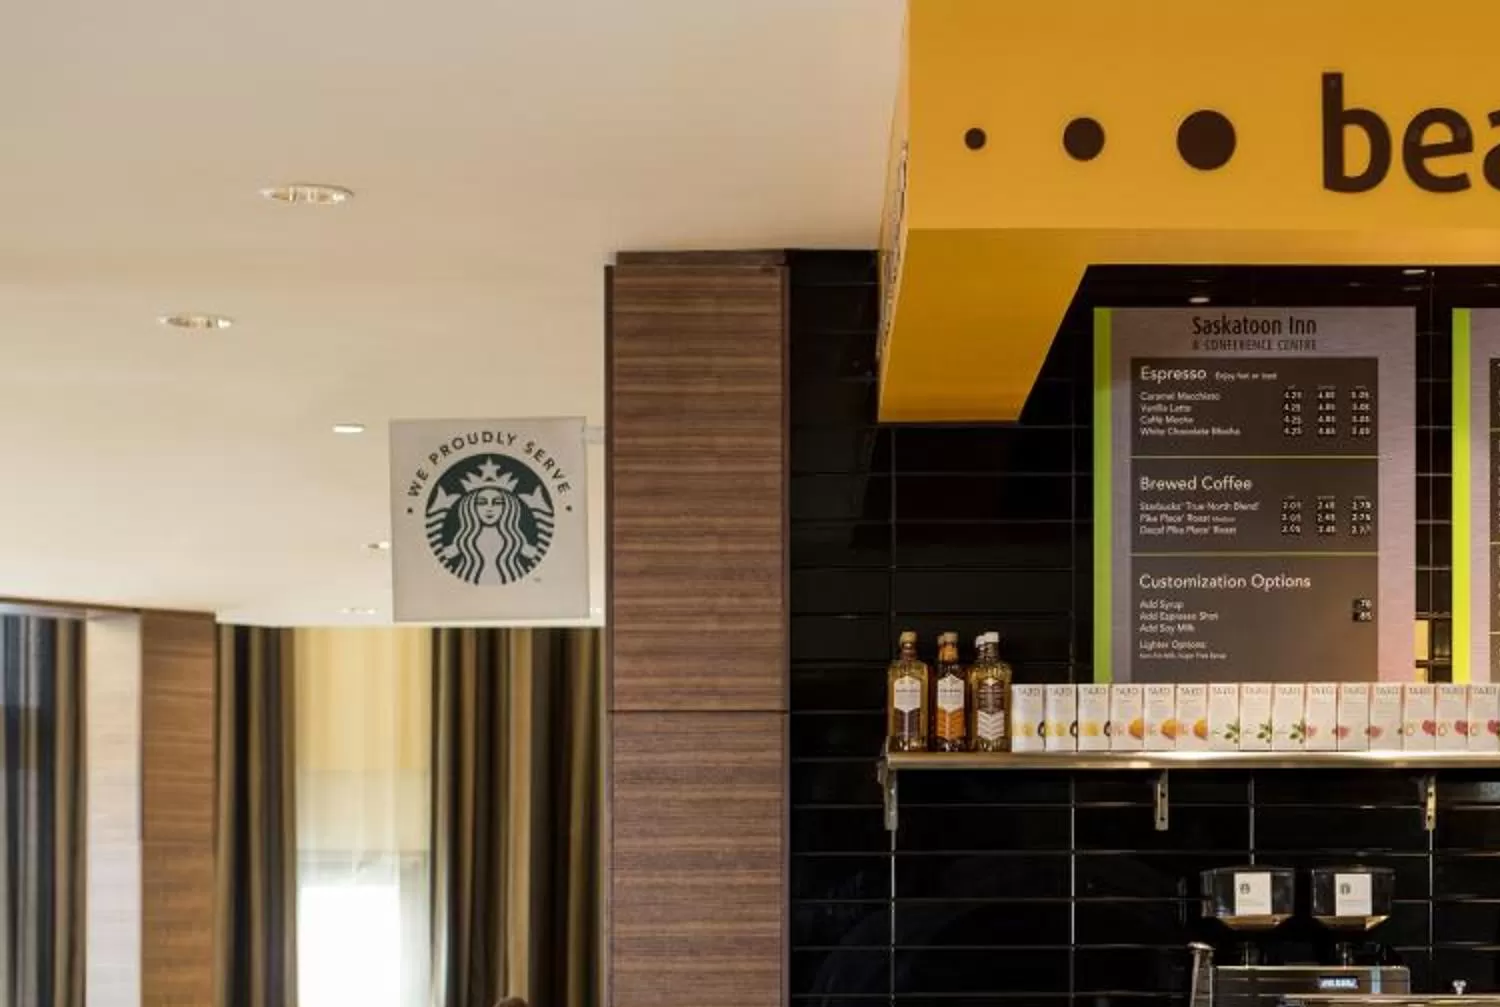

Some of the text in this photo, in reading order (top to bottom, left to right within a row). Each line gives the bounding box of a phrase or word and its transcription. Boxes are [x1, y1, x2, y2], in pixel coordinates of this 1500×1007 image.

[1191, 314, 1317, 335] Saskatoon Inn
[1278, 339, 1317, 350] CENTRE
[1140, 365, 1207, 384] Espresso
[408, 431, 572, 498] WE PROUDLY SERVE
[1139, 475, 1253, 490] Brewed Coffee
[1139, 573, 1312, 592] Customization Options
